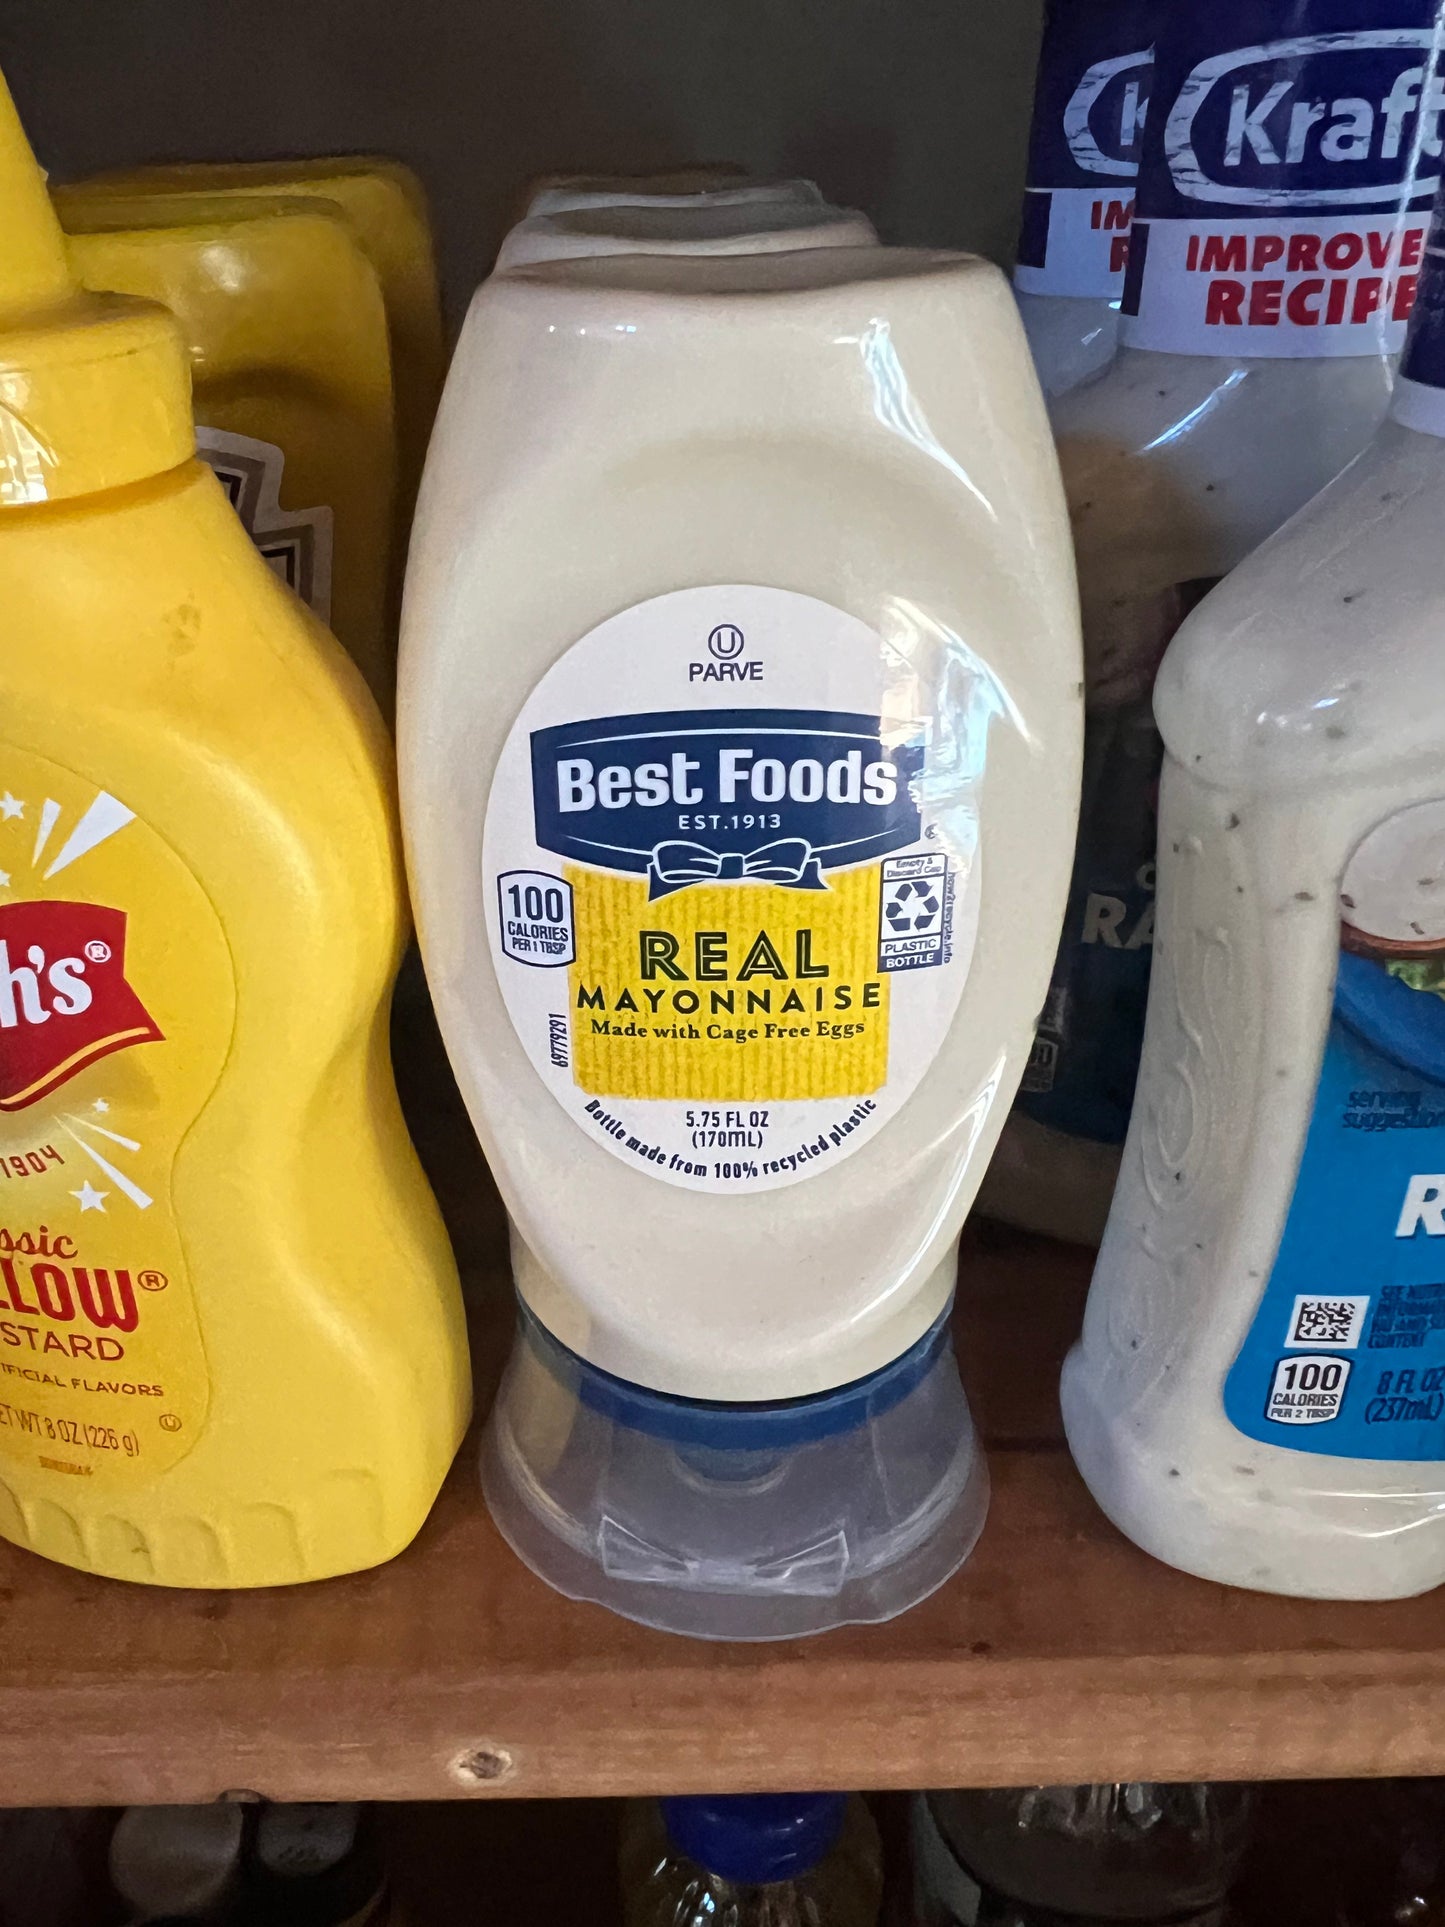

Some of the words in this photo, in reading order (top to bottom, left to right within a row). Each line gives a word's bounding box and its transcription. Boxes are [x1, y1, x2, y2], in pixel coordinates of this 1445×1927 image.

[1224, 67, 1445, 167] Kraft
[1205, 274, 1419, 326] RECIPE
[689, 661, 764, 682] PARVE
[557, 753, 703, 813] Best
[719, 749, 898, 806] Foods
[508, 884, 564, 923] 100
[507, 921, 569, 942] CALORIES
[512, 937, 531, 952] PER
[533, 941, 538, 952] 1
[539, 940, 566, 955] TBSP
[639, 929, 829, 982] REAL
[885, 939, 937, 954] PLASTIC
[886, 953, 935, 968] BOTTLE
[577, 983, 880, 1014] MAYONNAISE
[548, 1013, 569, 1068] 69779291
[591, 1018, 648, 1038] Made
[653, 1023, 701, 1039] with
[707, 1024, 758, 1043] Cage
[764, 1023, 810, 1038] Free
[816, 1020, 865, 1040] Eggs
[686, 1111, 720, 1128] 5.75
[726, 1111, 745, 1128] FL
[749, 1111, 769, 1128] OZ
[584, 1099, 626, 1140] Bottle
[625, 1136, 667, 1165] made
[669, 1153, 707, 1177] from
[714, 1161, 758, 1179] 100%
[762, 1134, 830, 1175] recycled
[829, 1099, 877, 1146] plastic
[0, 1144, 65, 1178] 1904
[0, 1256, 139, 1333] LOW
[0, 1321, 125, 1361] STARD
[71, 1378, 164, 1397] FLAVORS
[1284, 1363, 1342, 1391] 100
[1377, 1370, 1394, 1395] 8
[1271, 1408, 1292, 1418] PER
[1295, 1409, 1303, 1418] 2
[1306, 1408, 1335, 1419] TBSP
[1272, 1393, 1339, 1406] CALORIES
[15, 1409, 42, 1437] WT
[44, 1417, 56, 1440] 8
[57, 1419, 83, 1446] OZ
[83, 1424, 119, 1451] (226
[122, 1429, 139, 1457] g)
